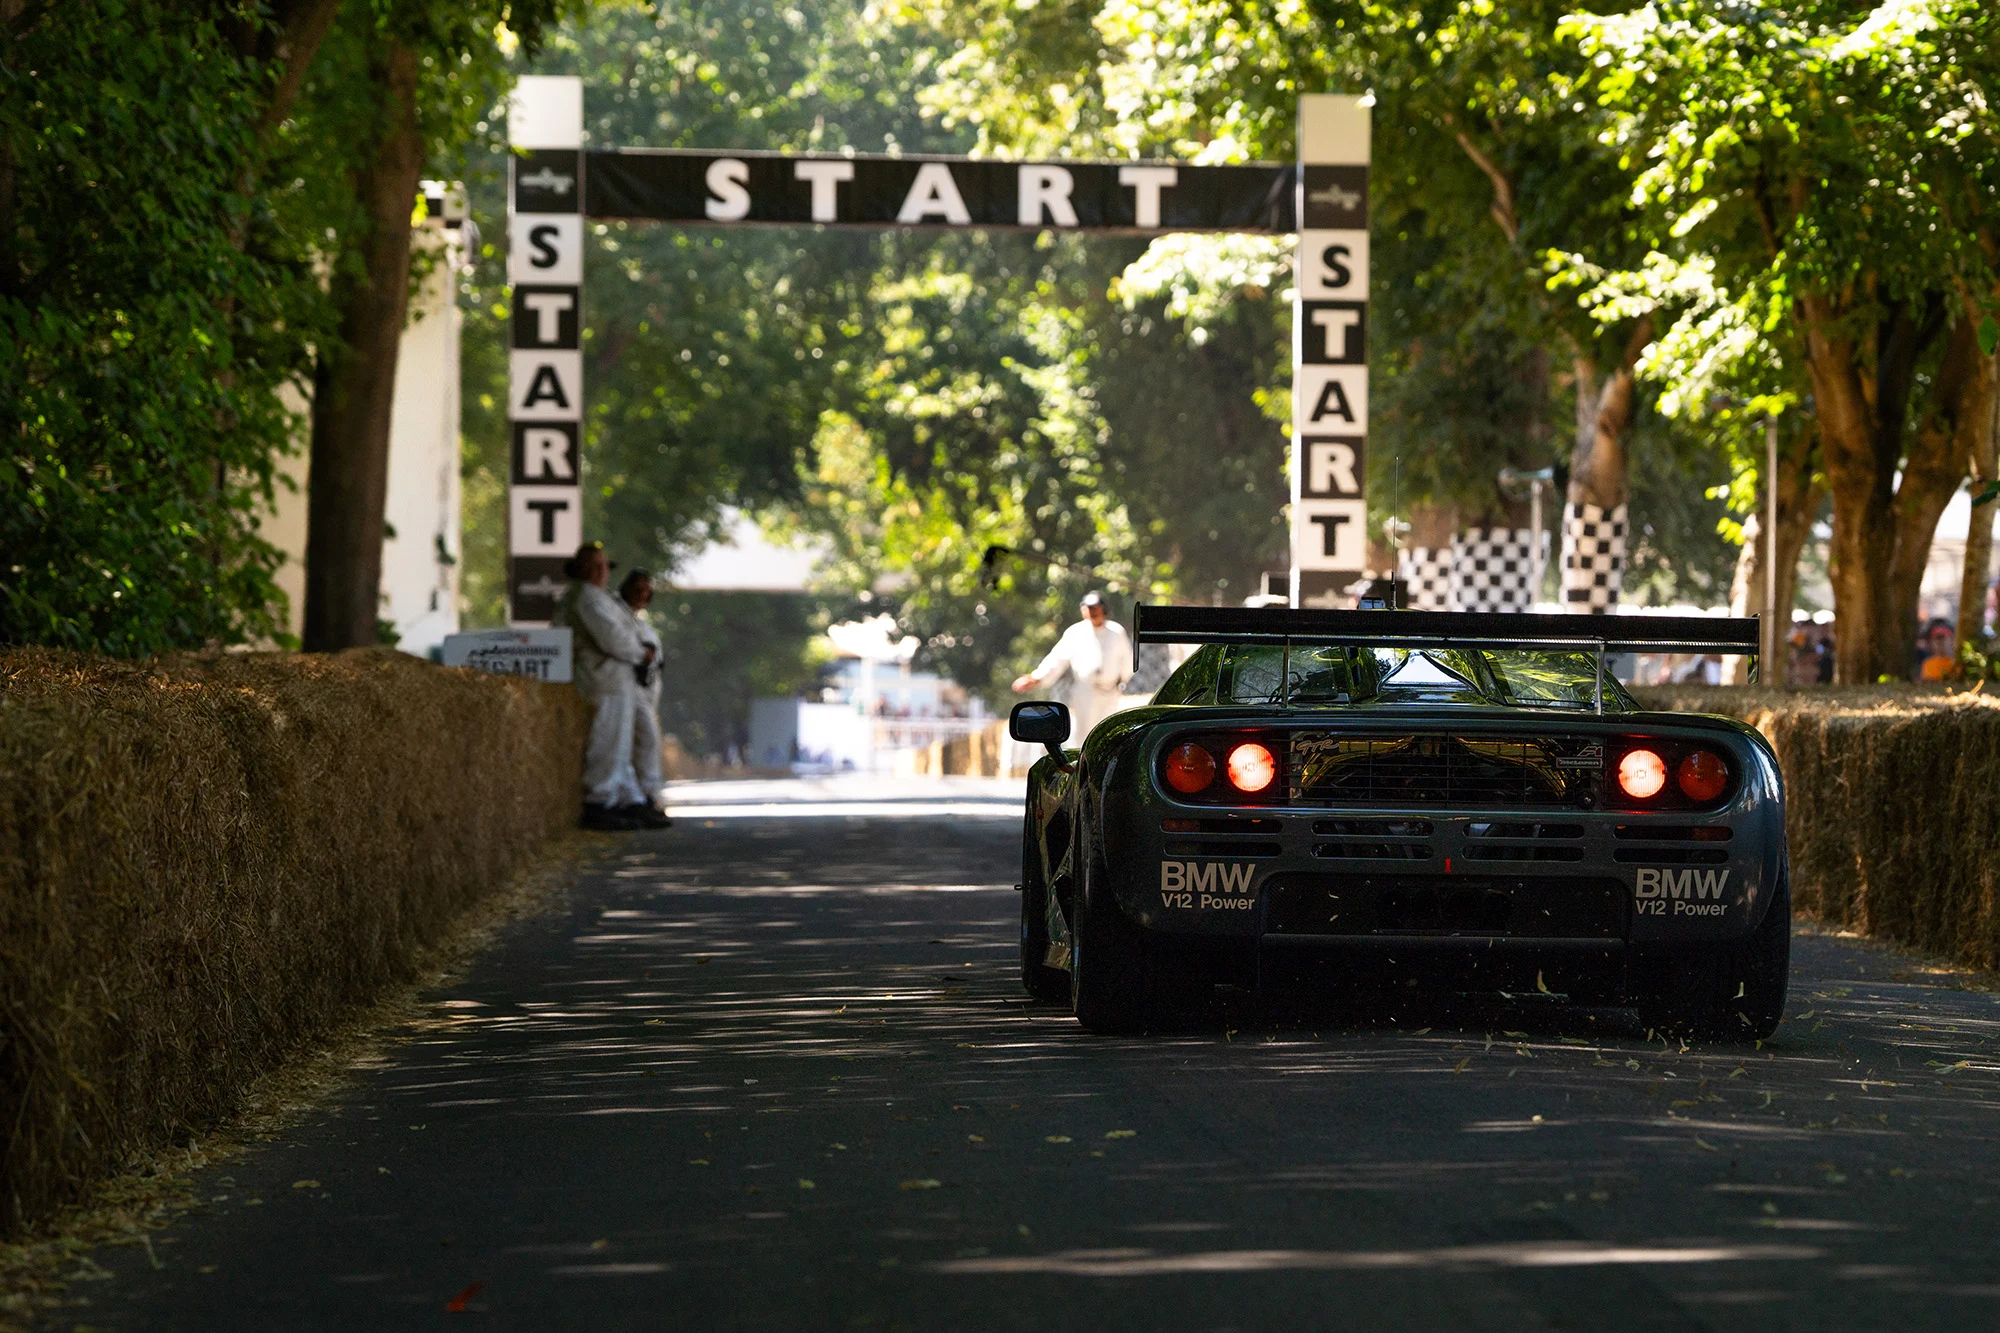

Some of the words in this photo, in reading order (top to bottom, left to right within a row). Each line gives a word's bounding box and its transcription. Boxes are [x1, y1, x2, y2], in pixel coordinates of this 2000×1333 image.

[704, 157, 1179, 228] START
[522, 224, 574, 545] START
[1308, 244, 1360, 557] START
[1296, 739, 1339, 755] GTR
[1161, 861, 1256, 893] BMW
[1635, 868, 1730, 899] BMW
[1161, 893, 1193, 909] V12
[1201, 894, 1255, 910] Power
[1635, 900, 1667, 915] V12
[1673, 901, 1728, 916] Power
